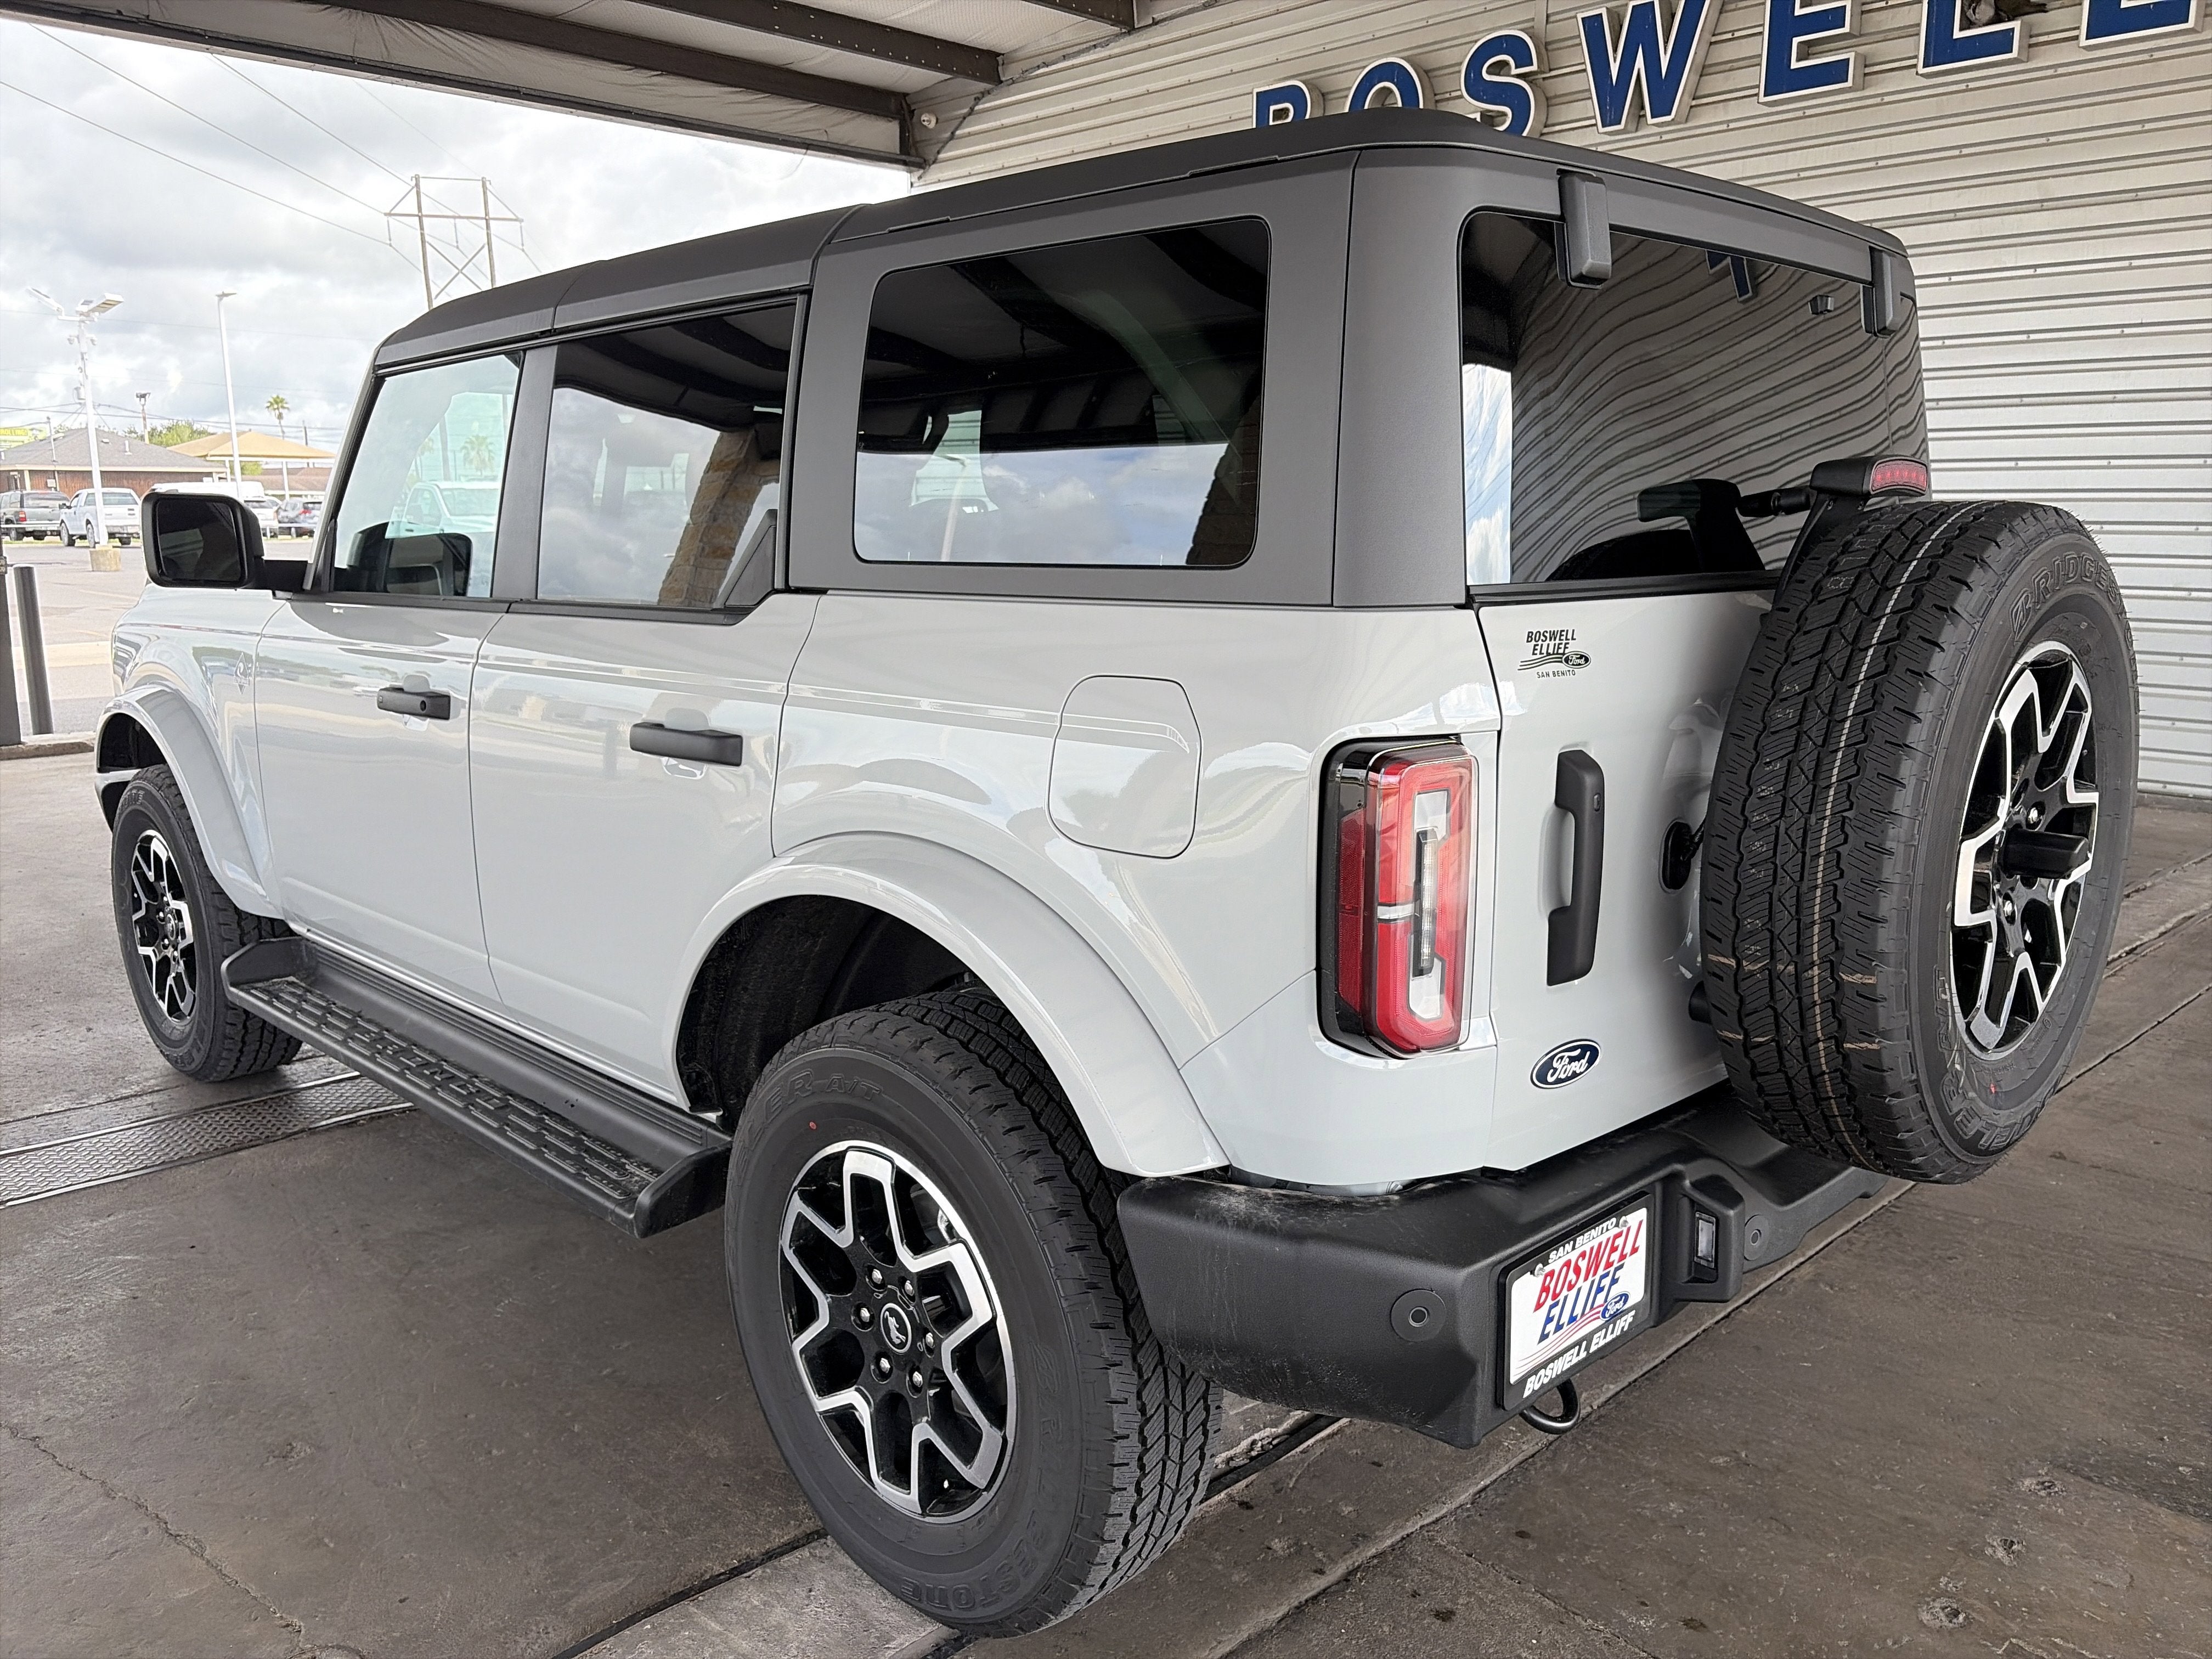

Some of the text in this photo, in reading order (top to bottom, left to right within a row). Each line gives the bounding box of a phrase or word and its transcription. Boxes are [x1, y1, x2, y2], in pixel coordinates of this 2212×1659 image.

[1526, 629, 1577, 643] BOSWELL
[1532, 642, 1570, 656] ELLIFF
[1552, 669, 1576, 678] BENITO
[1567, 654, 1586, 665] Ford
[1547, 1048, 1590, 1082] Ford
[824, 1073, 884, 1101] A/T
[1548, 1217, 1617, 1264] SAN BENITO
[1533, 1219, 1644, 1313] BOSWELL
[1537, 1261, 1627, 1345] ELLIFF
[1605, 1297, 1624, 1318] Ford
[1522, 1310, 1636, 1399] BOSWELL ELLIFF
